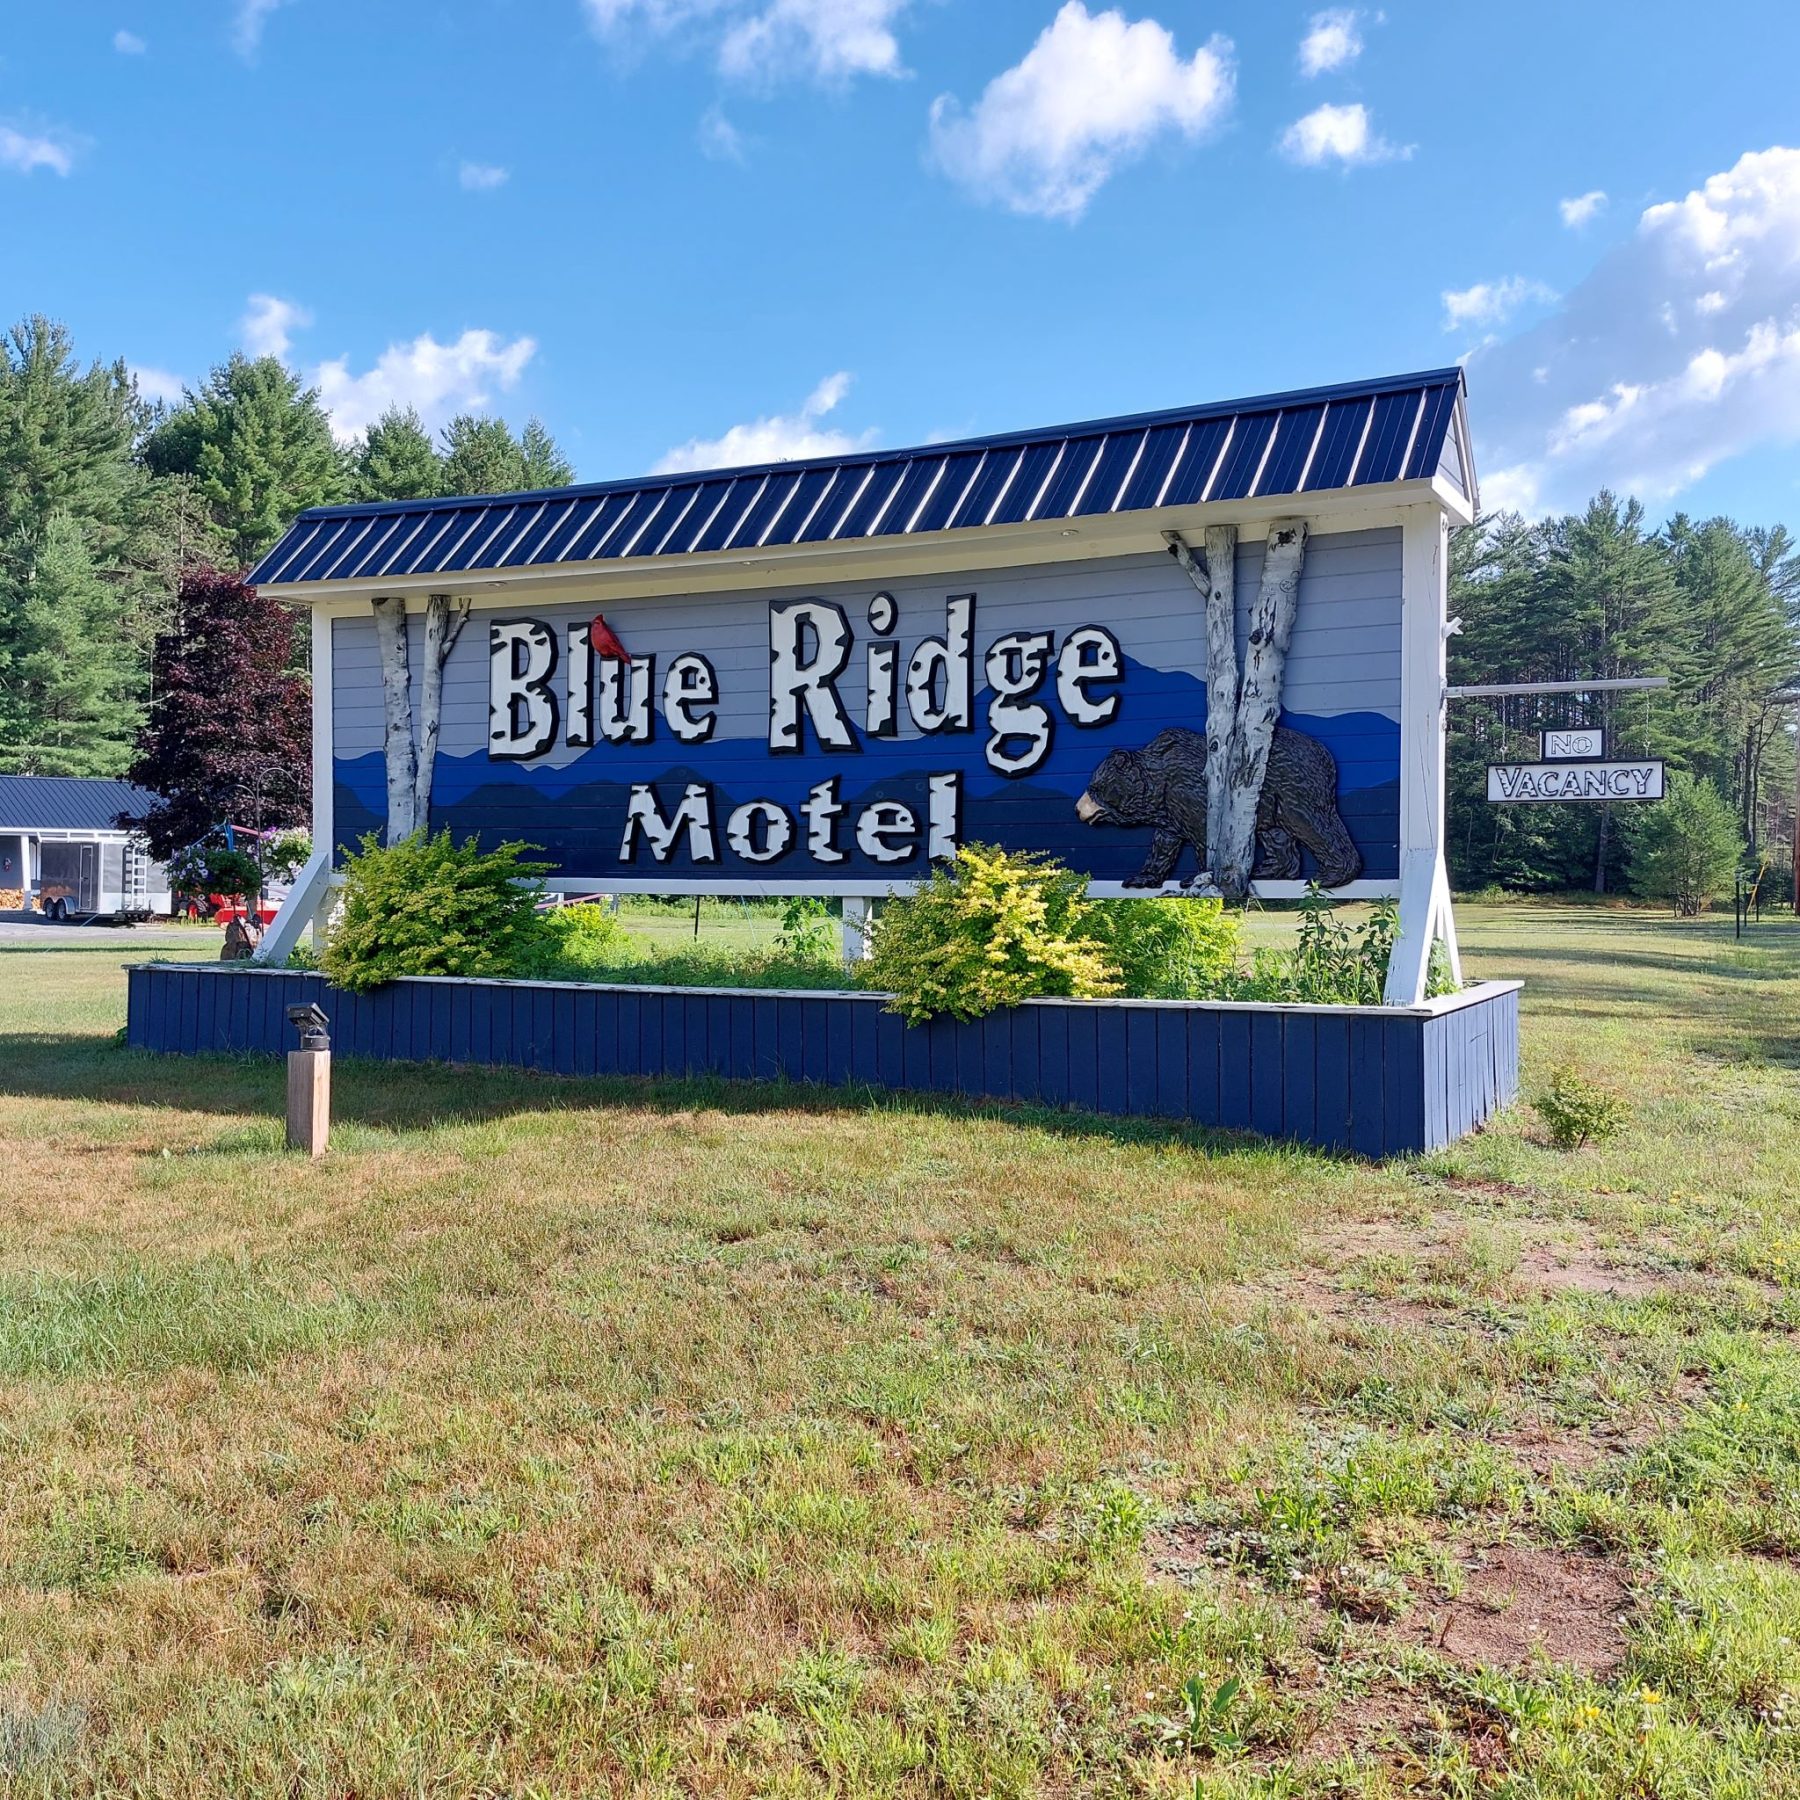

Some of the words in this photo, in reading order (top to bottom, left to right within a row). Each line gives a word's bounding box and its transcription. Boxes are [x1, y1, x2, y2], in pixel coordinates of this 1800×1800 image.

[489, 617, 719, 760] Blue
[769, 593, 1125, 776] Ridge
[618, 770, 964, 863] Motel
[1495, 767, 1653, 798] VACANCY
